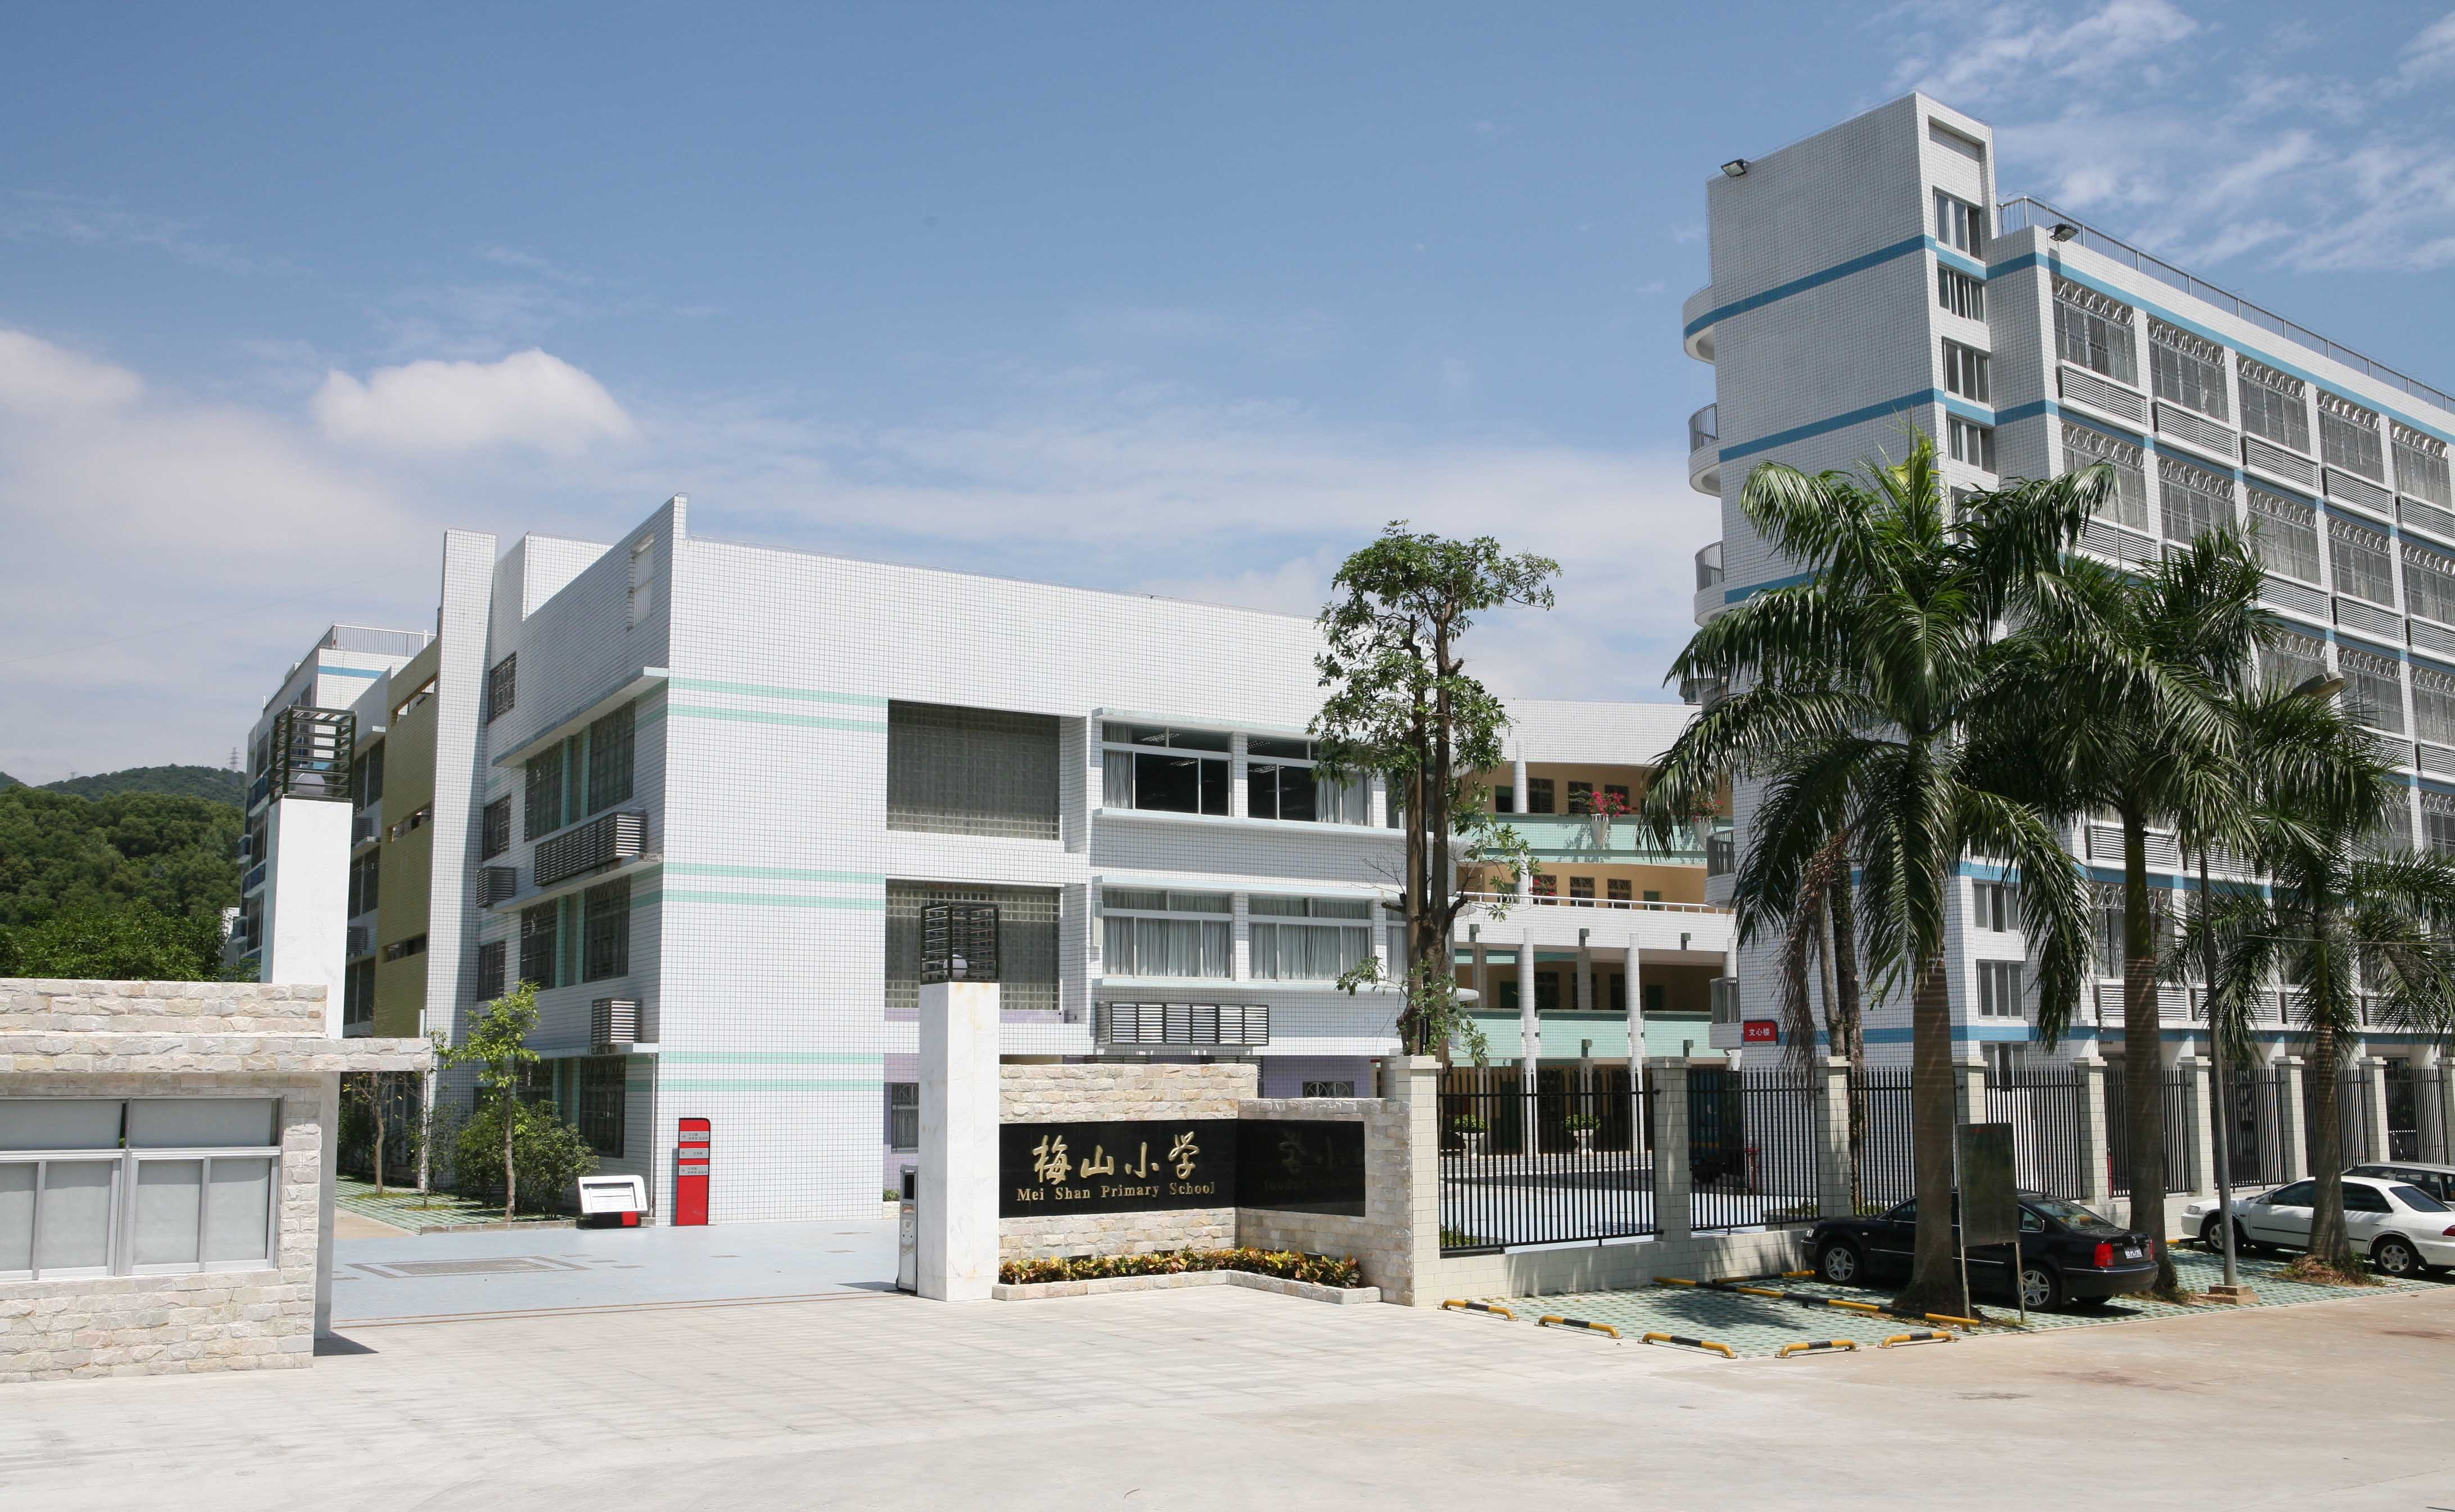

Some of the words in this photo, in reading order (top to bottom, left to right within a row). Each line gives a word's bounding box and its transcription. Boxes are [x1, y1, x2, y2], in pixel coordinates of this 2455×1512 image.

[1749, 1028, 1770, 1037] 文心楼
[1032, 1131, 1200, 1184] 梅山小学
[1016, 1188, 1044, 1201] Mei
[1055, 1187, 1090, 1200] Shan
[1101, 1184, 1159, 1198] Primary
[1169, 1182, 1215, 1195] School
